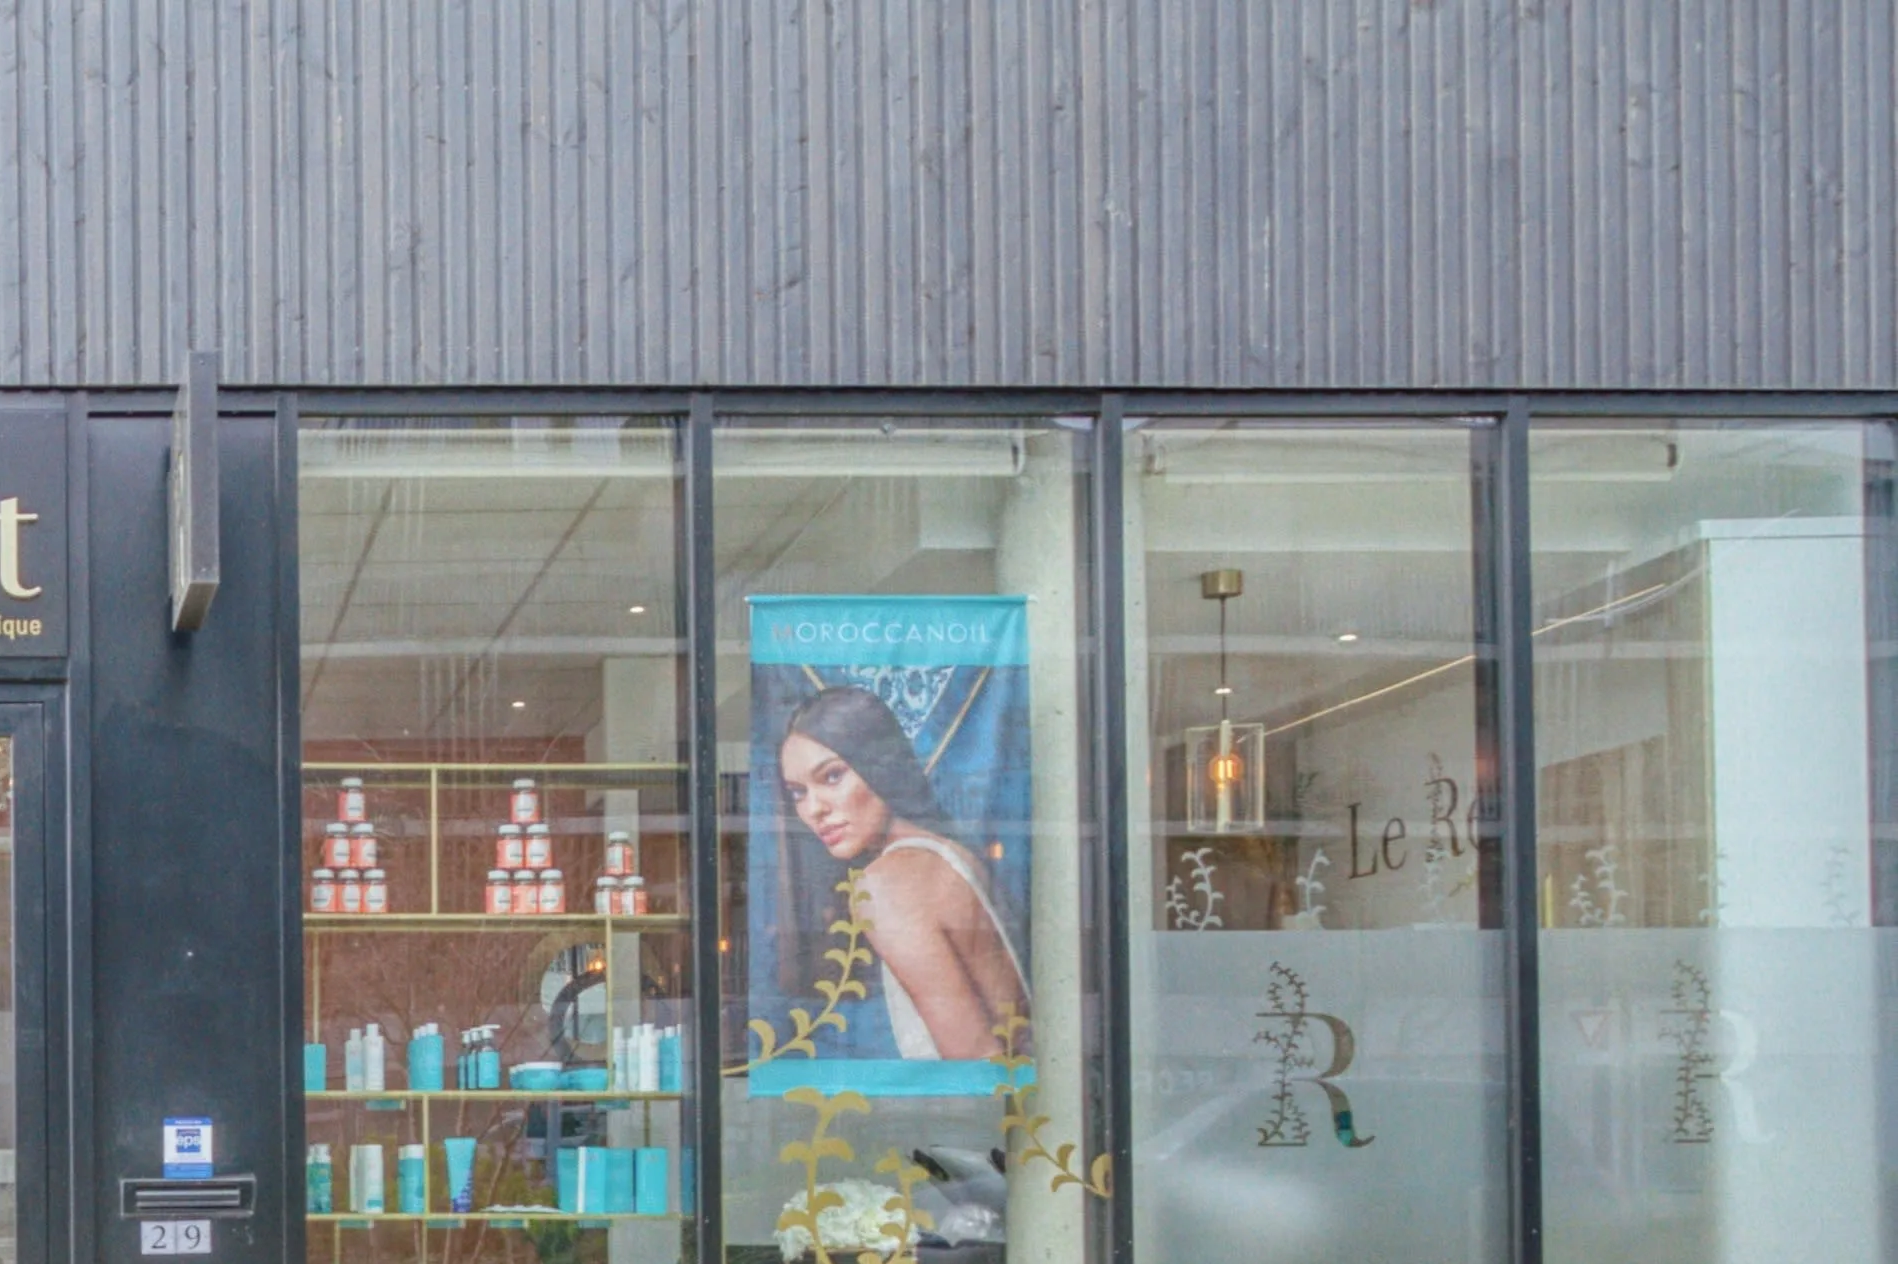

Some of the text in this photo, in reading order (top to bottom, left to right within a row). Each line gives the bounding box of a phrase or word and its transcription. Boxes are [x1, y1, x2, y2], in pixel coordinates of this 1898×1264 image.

[771, 621, 992, 644] MOROCCANOIL
[1347, 802, 1407, 880] Le
[150, 1223, 202, 1250] 29
